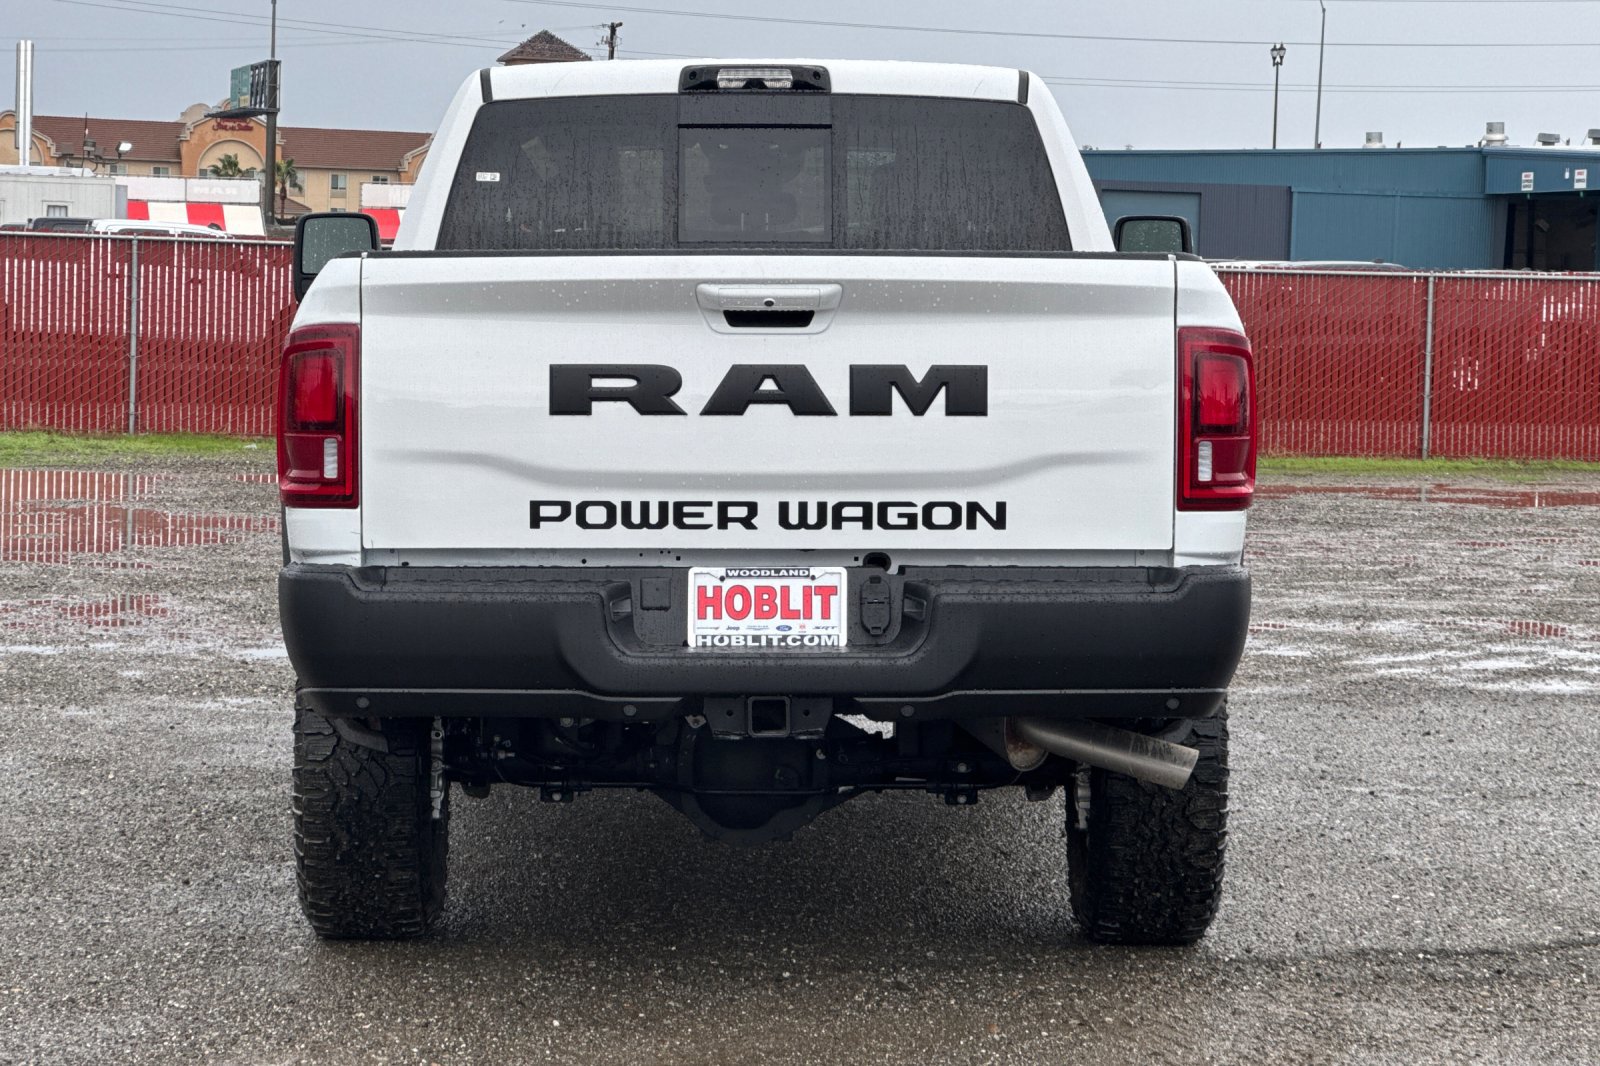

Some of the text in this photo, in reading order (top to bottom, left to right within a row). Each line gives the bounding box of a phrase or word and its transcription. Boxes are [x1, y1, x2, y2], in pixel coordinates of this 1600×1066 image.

[549, 364, 988, 416] RAM
[529, 500, 1007, 530] POWER WAGON
[727, 569, 809, 577] WOODLAND
[697, 585, 838, 620] HOBLIT
[696, 635, 839, 646] HOBLIT.COM
